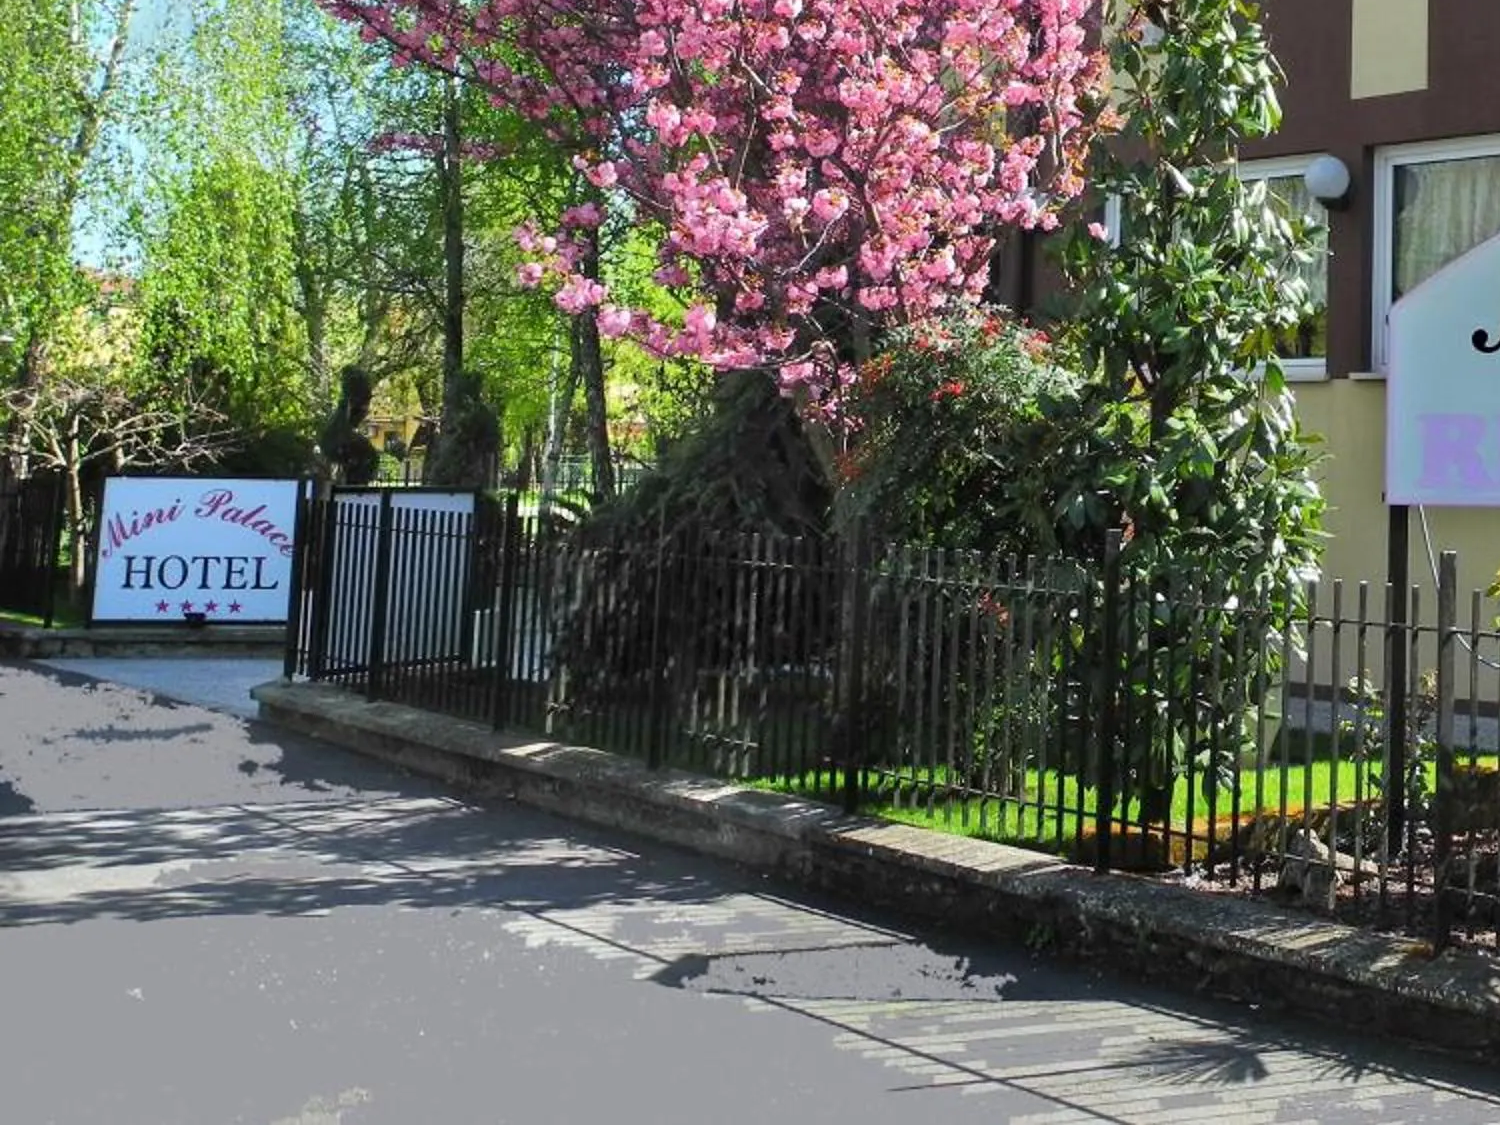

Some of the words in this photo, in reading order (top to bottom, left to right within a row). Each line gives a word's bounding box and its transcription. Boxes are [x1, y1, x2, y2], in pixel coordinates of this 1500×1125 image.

[102, 499, 185, 558] Mini
[194, 489, 295, 557] Palace
[121, 555, 279, 590] HOTEL
